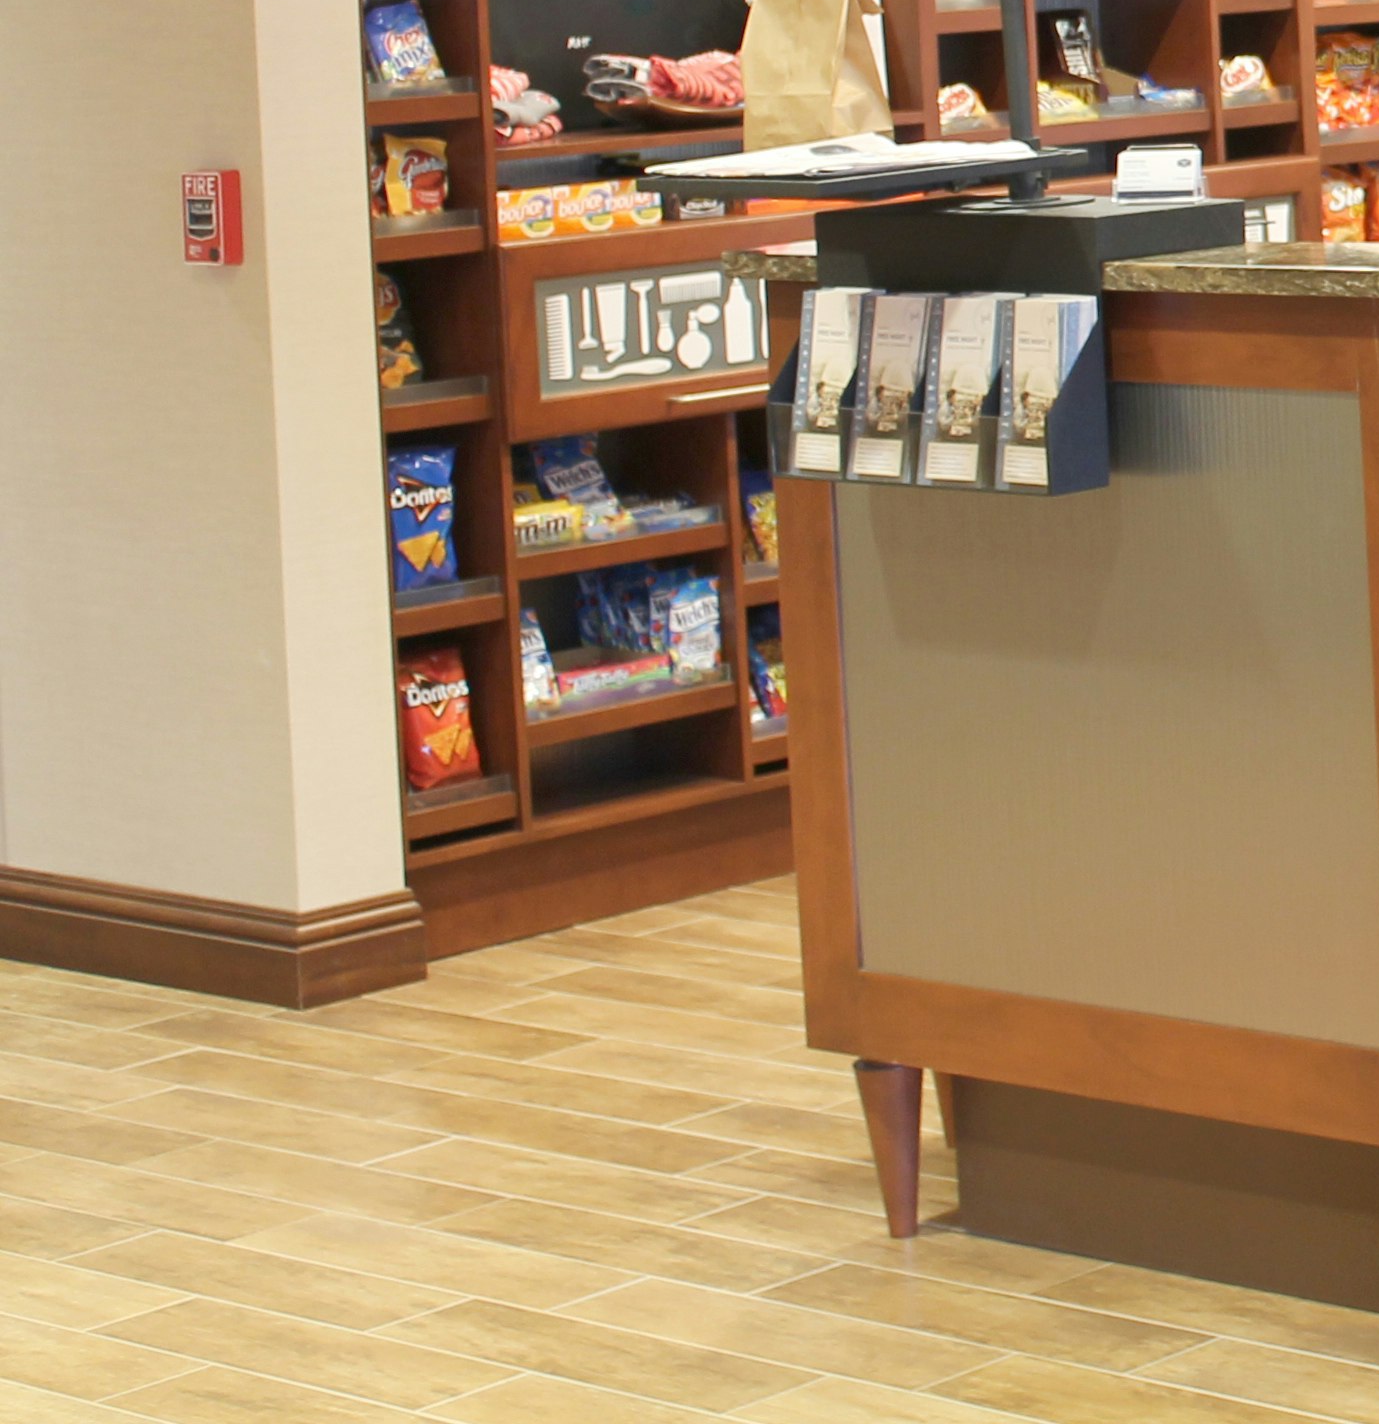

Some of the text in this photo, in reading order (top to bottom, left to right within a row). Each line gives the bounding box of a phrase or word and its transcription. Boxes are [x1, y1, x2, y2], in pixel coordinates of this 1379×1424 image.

[184, 176, 216, 196] FIRE
[499, 197, 548, 224] bounce
[559, 191, 606, 217] bounce
[391, 485, 453, 509] Doritos
[675, 596, 718, 627] Welch's
[406, 679, 470, 708] Doritos
